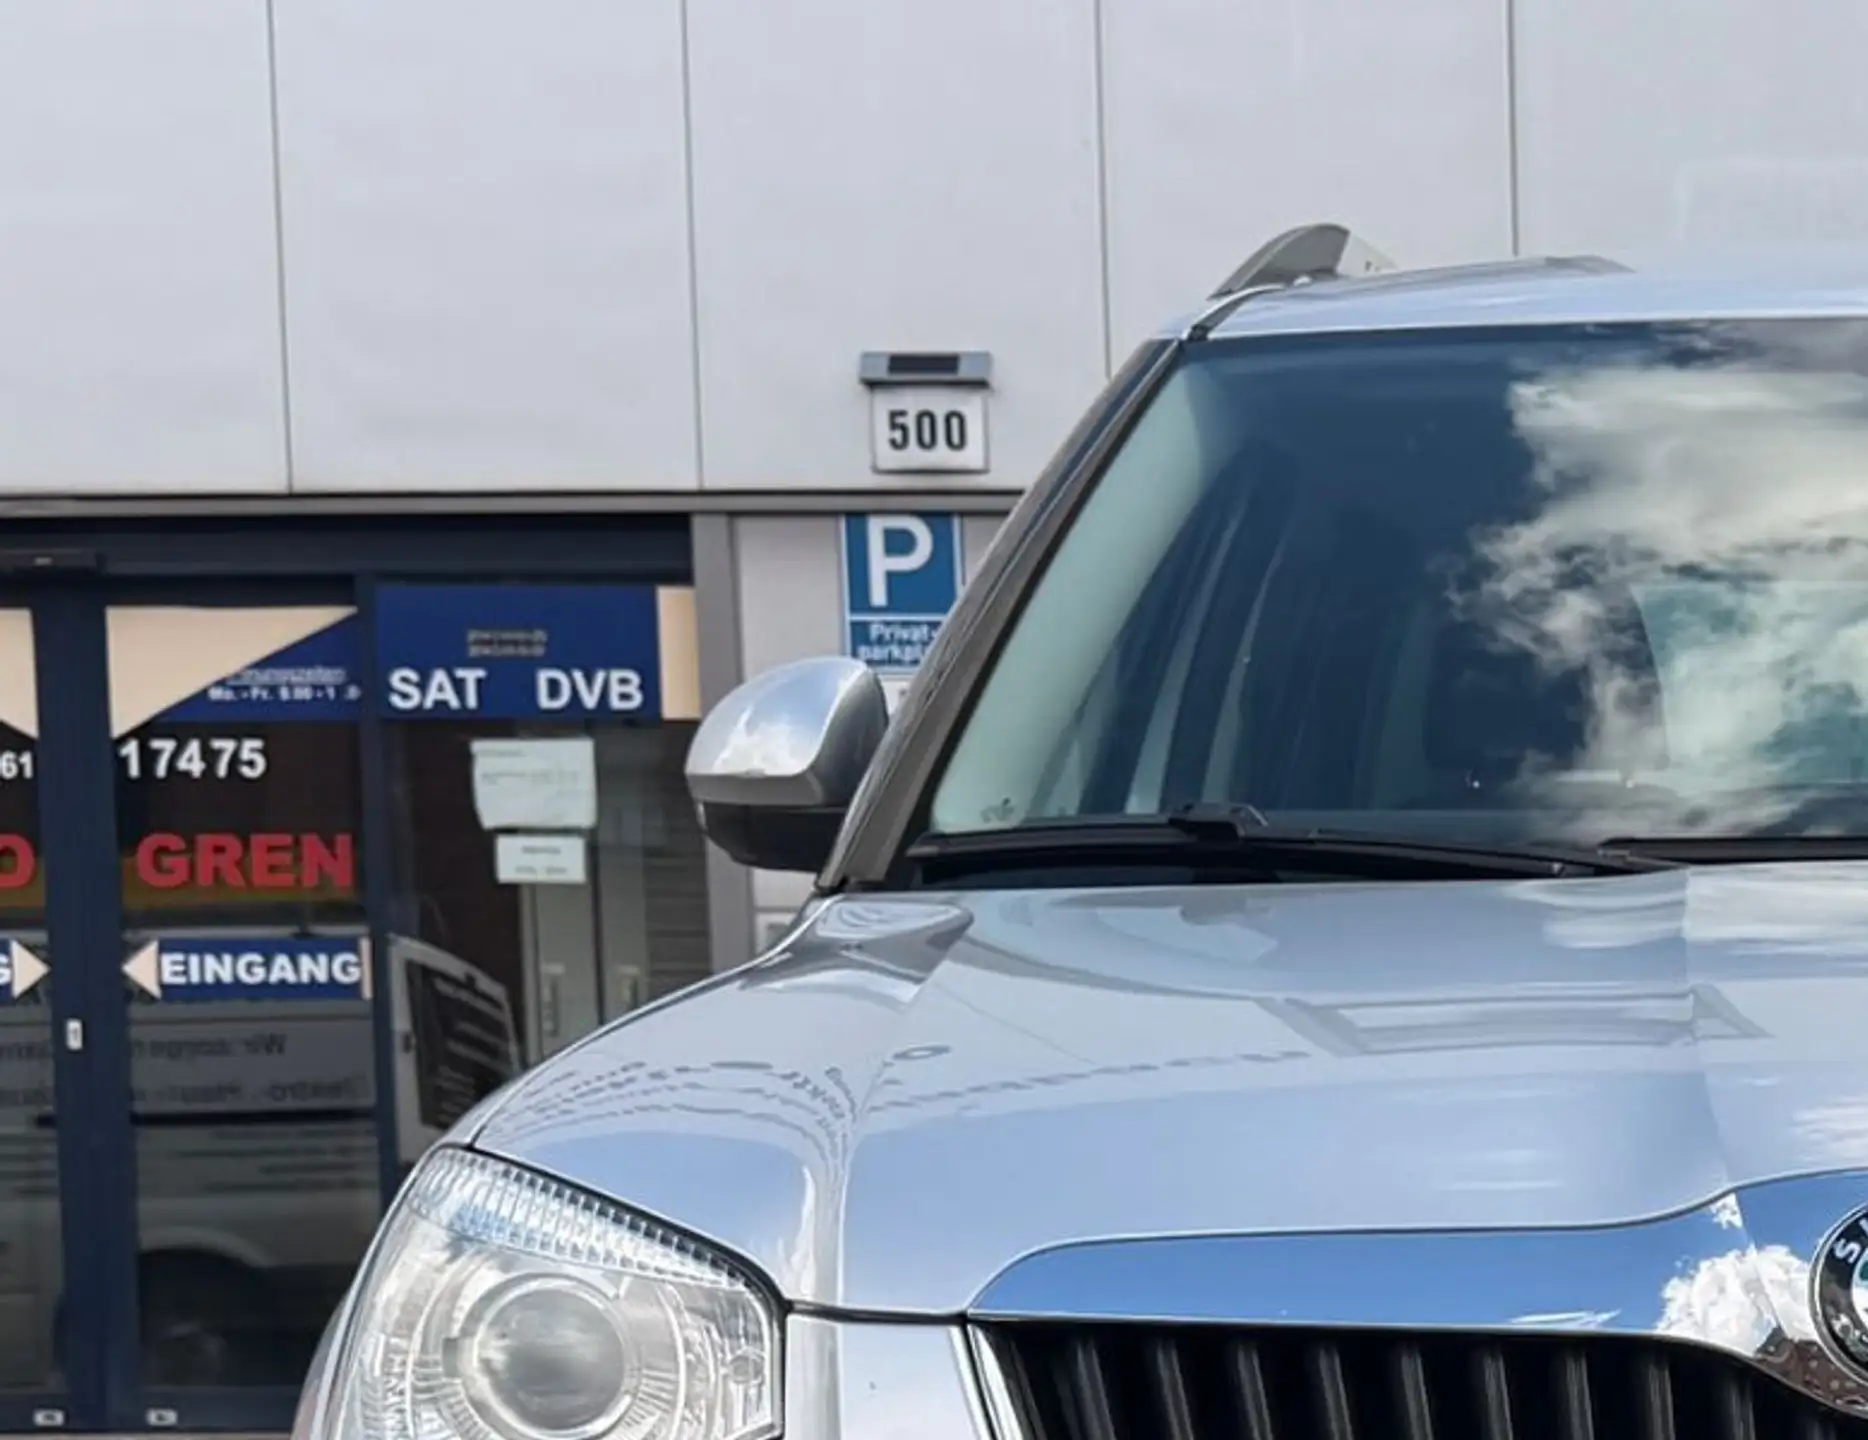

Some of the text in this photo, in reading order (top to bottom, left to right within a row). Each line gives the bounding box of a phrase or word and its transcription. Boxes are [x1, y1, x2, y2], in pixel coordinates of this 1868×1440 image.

[888, 410, 967, 450] 500
[867, 514, 933, 607] P
[389, 669, 487, 709] SAT
[536, 669, 644, 710] DVB
[0, 738, 268, 779] 61 17475
[136, 833, 353, 888] GREN
[160, 953, 361, 985] EINGANG
